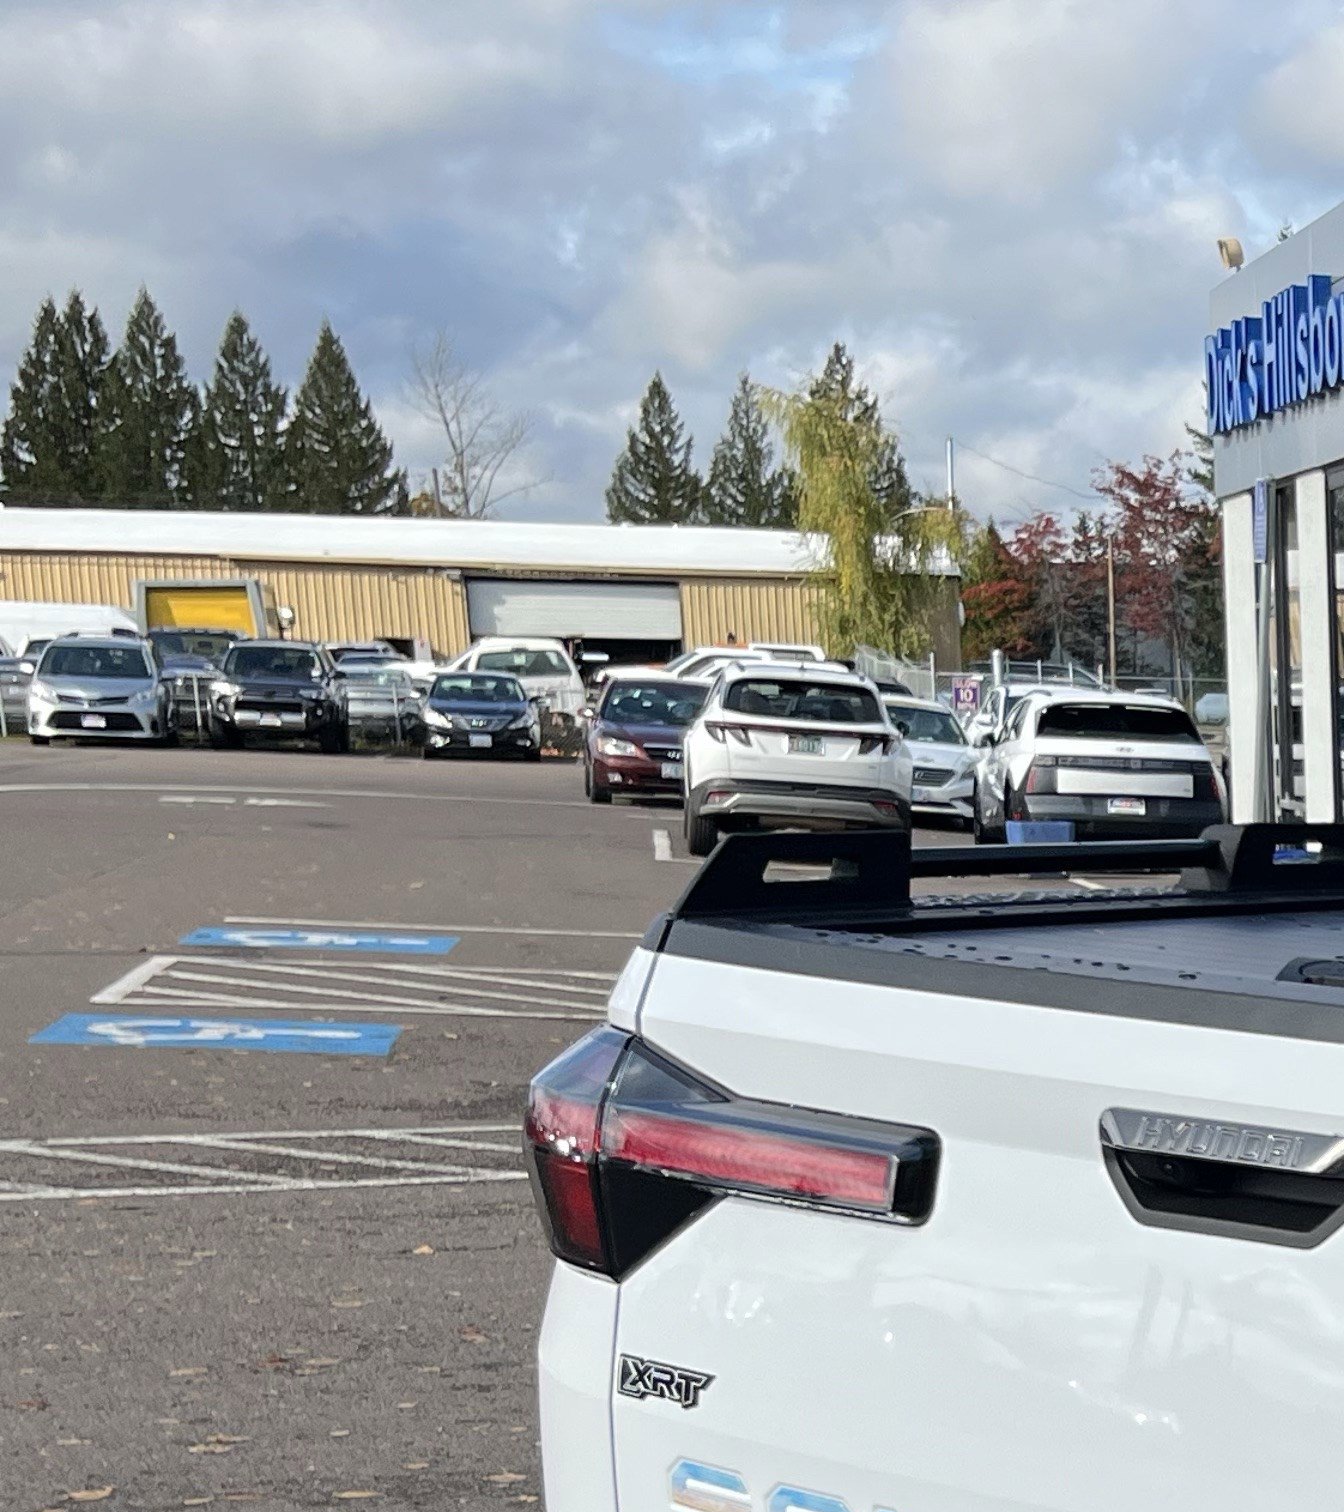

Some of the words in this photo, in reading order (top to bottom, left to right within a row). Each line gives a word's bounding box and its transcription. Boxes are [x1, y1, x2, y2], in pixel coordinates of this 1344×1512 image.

[1205, 316, 1259, 436] Dick's
[1134, 1115, 1304, 1168] HYUNDAI
[619, 1354, 716, 1409] XRT
